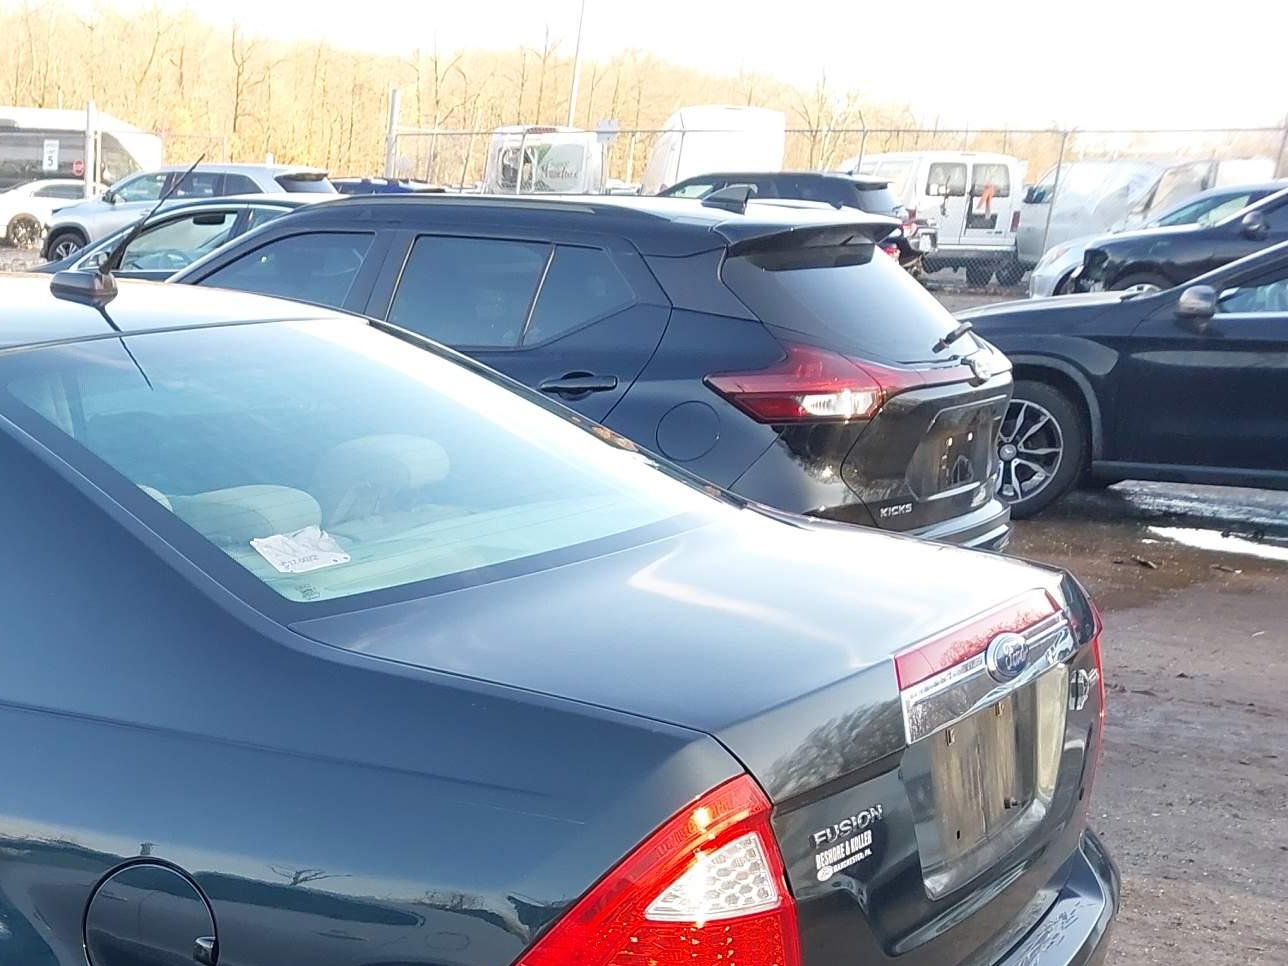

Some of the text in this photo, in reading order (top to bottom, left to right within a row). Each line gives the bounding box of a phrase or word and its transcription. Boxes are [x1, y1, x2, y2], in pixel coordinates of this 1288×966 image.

[47, 155, 53, 167] 5
[880, 503, 912, 517] KICKS
[1003, 640, 1029, 670] Ford
[814, 804, 883, 849] FUSION
[850, 830, 872, 853] KOLLER
